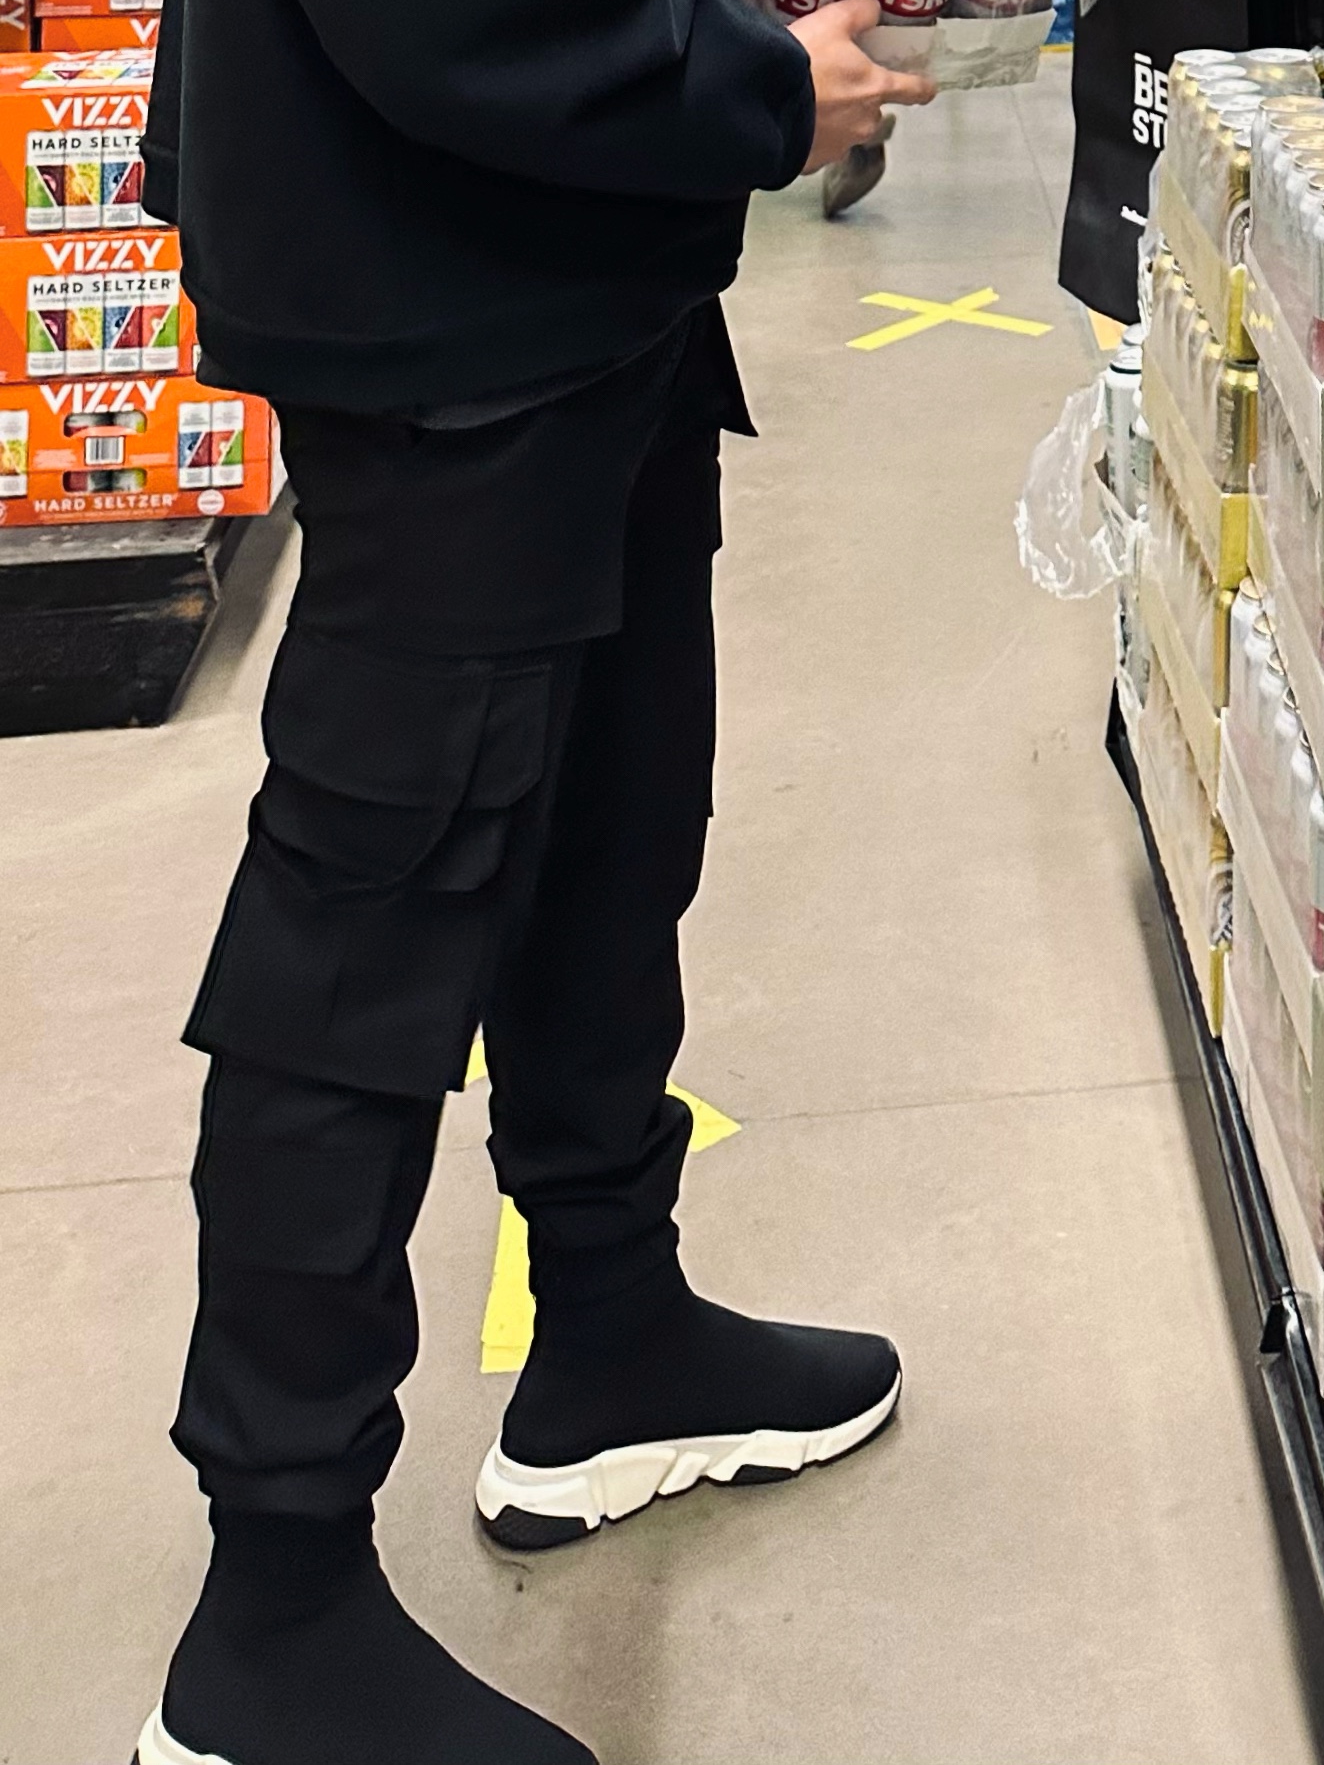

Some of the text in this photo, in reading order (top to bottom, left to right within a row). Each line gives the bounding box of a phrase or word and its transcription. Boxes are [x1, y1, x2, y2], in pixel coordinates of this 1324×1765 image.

[32, 136, 82, 151] HARD
[42, 238, 165, 271] VIZZY
[33, 278, 172, 296] HARD SELTZER
[40, 379, 167, 415] VIZZY
[34, 494, 175, 513] HARD SELTZER
